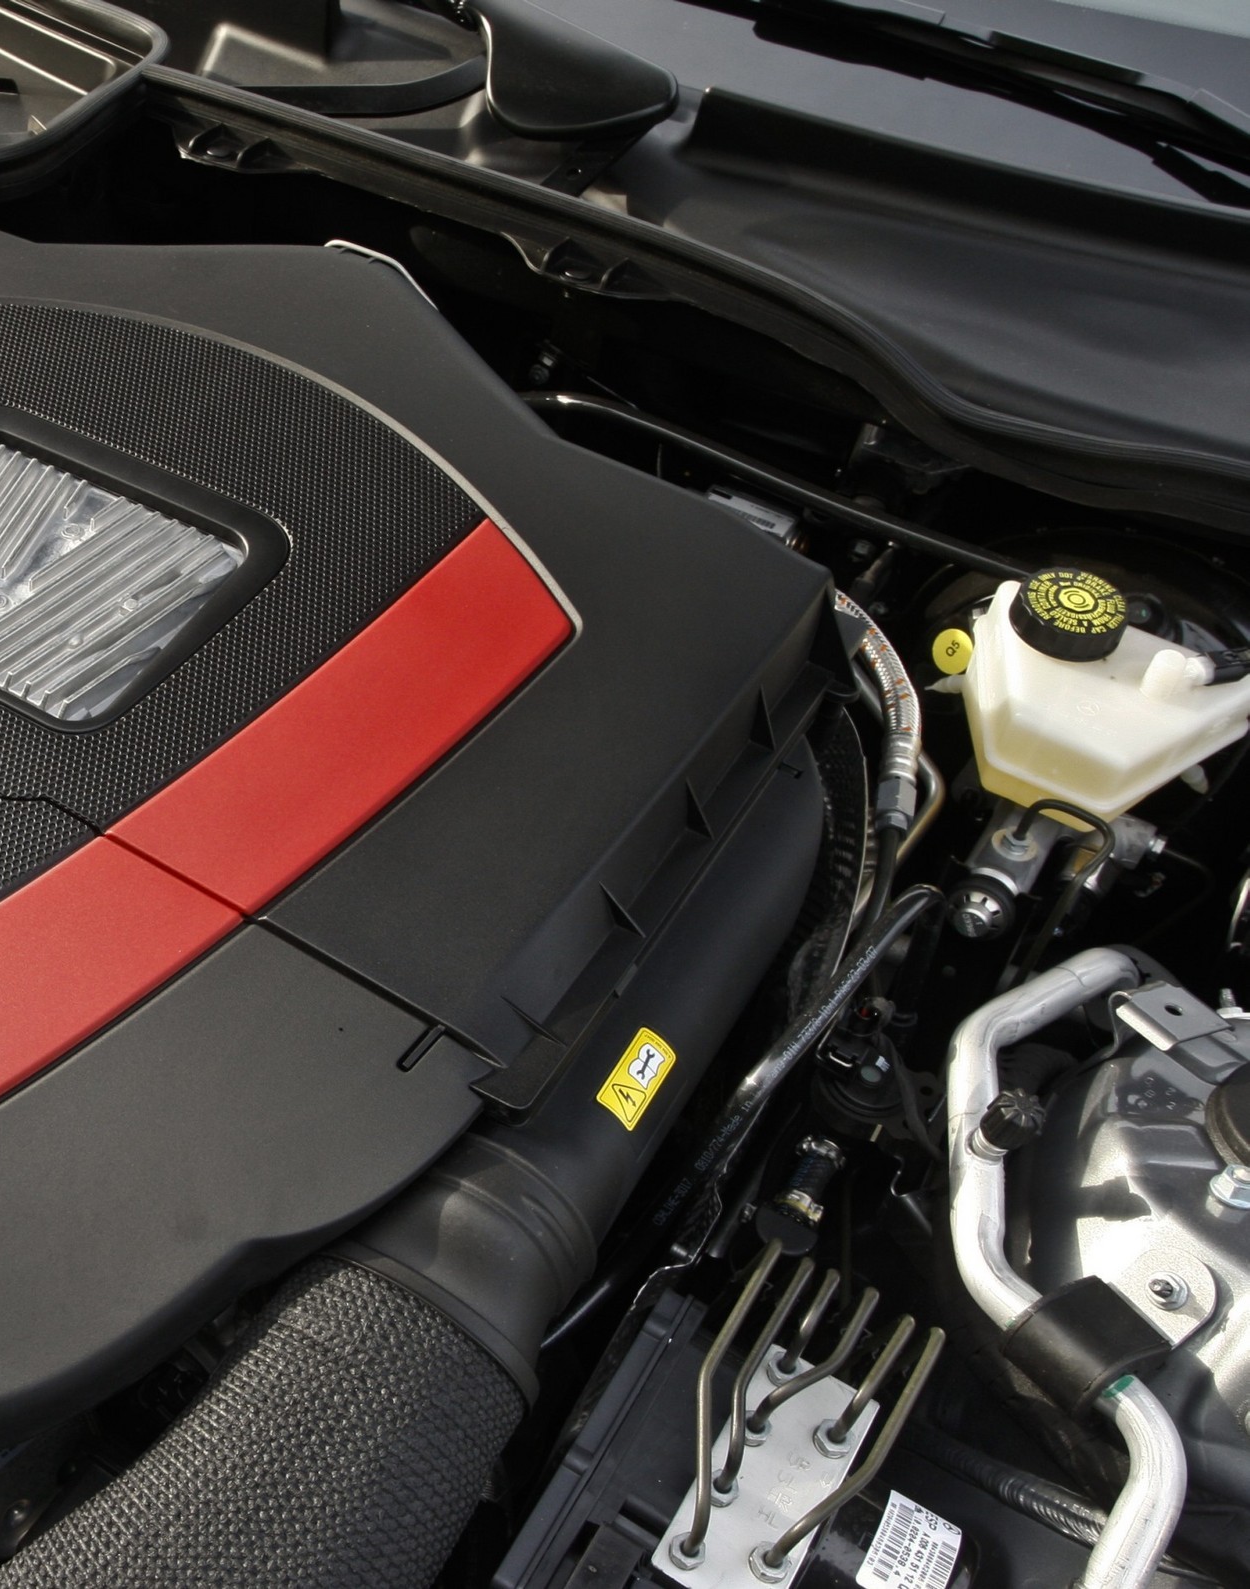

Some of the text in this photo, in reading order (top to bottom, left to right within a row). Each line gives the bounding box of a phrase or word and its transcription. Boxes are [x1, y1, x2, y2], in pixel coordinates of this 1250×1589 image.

[1058, 571, 1073, 579] DOT
[1080, 571, 1116, 593] WARNING
[1091, 625, 1107, 634] CAP
[945, 640, 960, 657] Q5
[913, 1549, 925, 1563] 431
[908, 1561, 920, 1573] 51
[903, 1573, 915, 1584] 12
